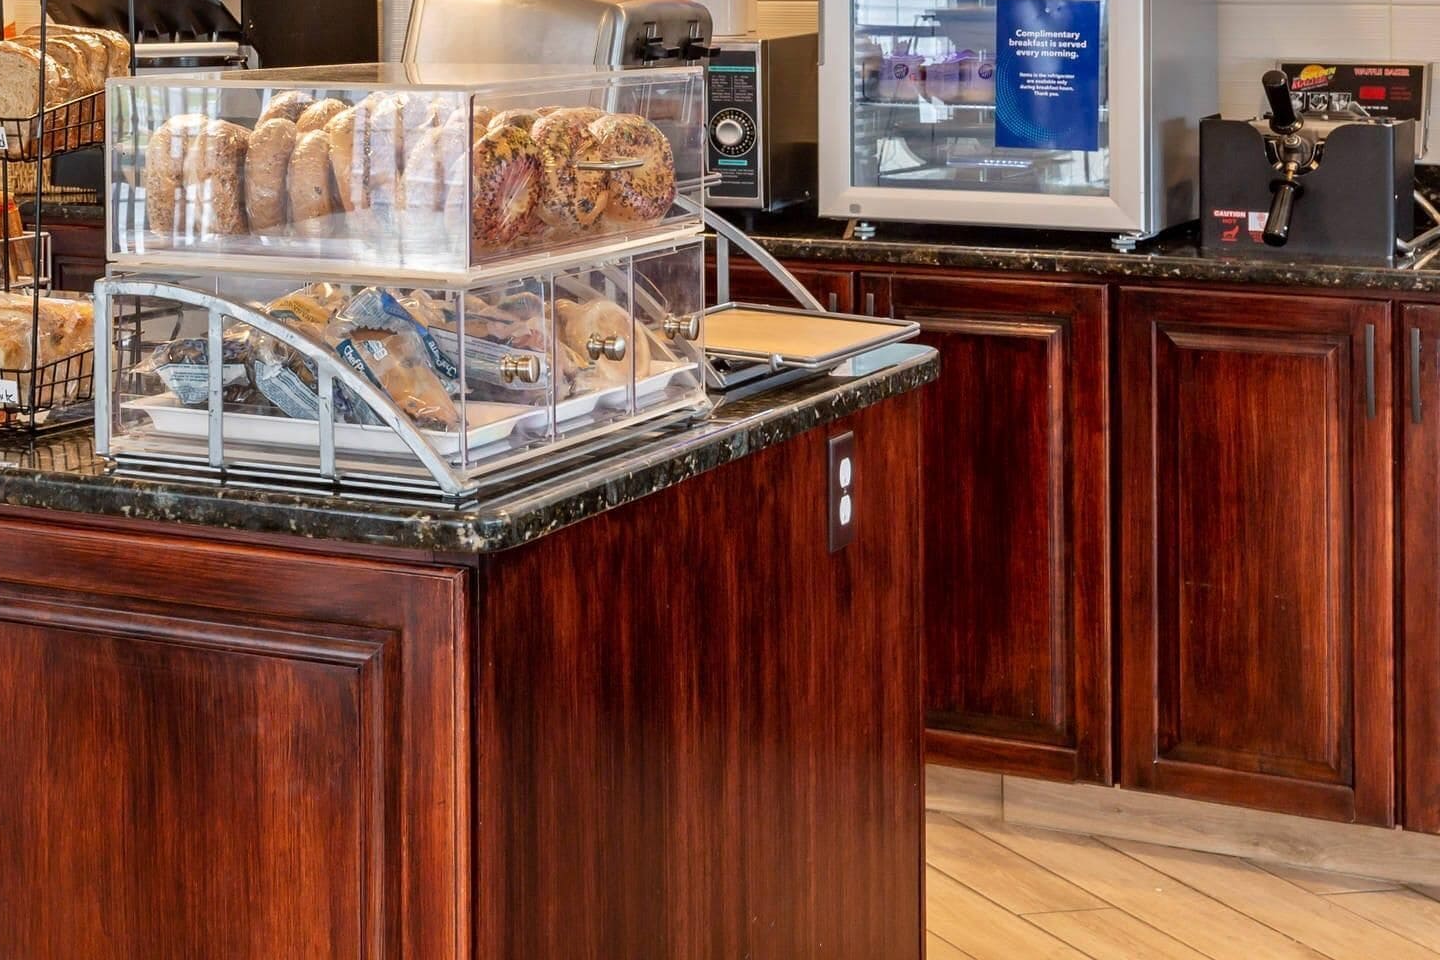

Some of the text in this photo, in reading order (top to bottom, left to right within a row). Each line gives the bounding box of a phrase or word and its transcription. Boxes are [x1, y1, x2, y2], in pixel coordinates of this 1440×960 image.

[1015, 29, 1080, 40] Complimentary
[1008, 38, 1048, 47] breakfast
[1058, 40, 1087, 48] served
[1016, 49, 1079, 60] every morning.
[1213, 210, 1247, 218] CAUTION
